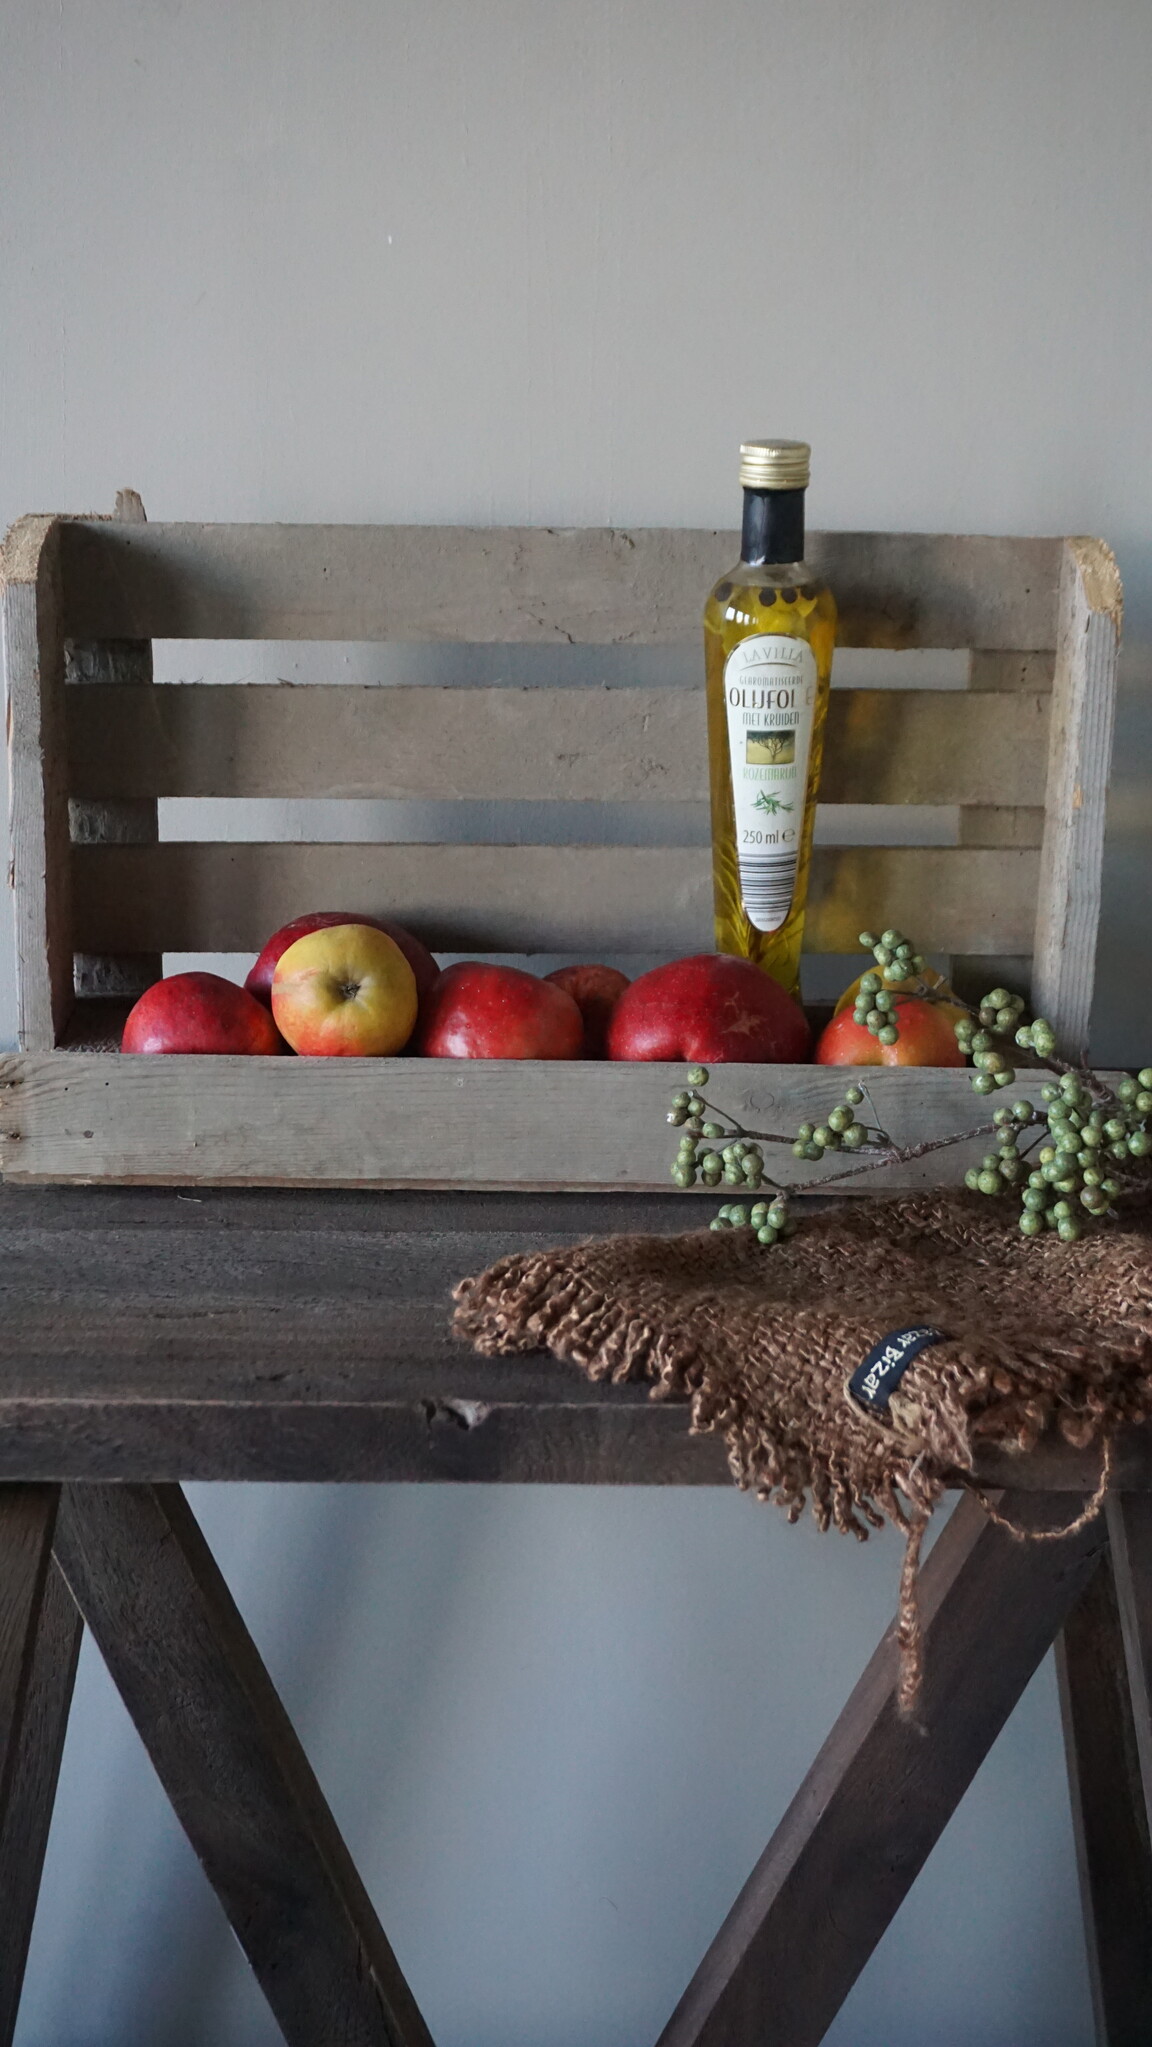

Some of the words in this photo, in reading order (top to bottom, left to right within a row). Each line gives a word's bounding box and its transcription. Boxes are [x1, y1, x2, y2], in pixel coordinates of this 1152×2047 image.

[729, 686, 814, 710] OLIJFOLE
[742, 712, 761, 727] MET
[764, 711, 800, 727] KRUIDEN
[743, 829, 763, 844] 250
[765, 829, 779, 844] ml
[861, 1345, 905, 1400] Bizar
